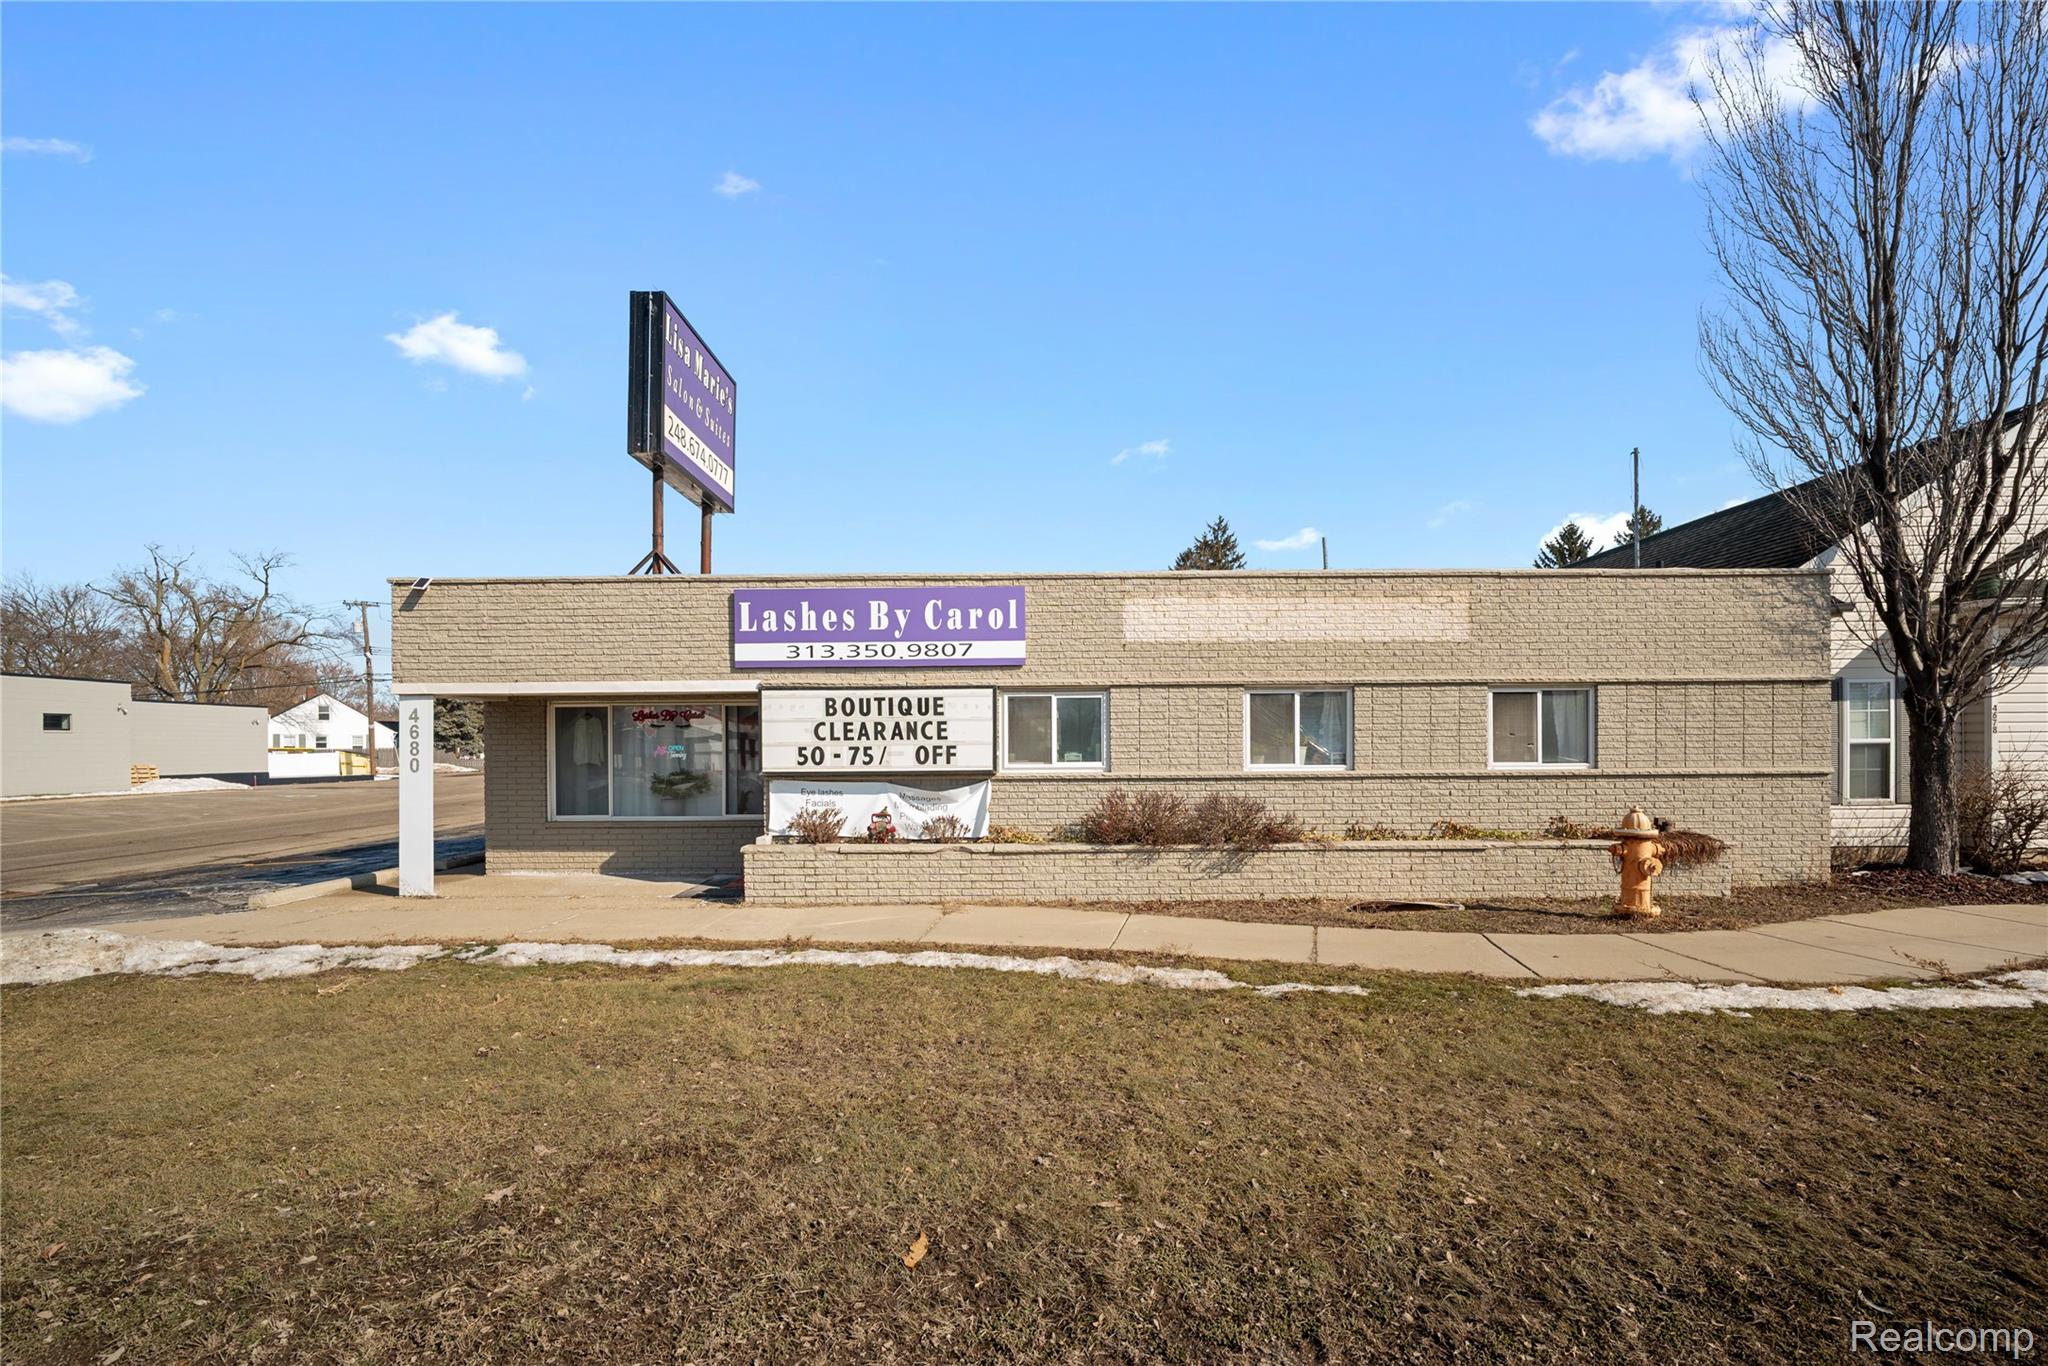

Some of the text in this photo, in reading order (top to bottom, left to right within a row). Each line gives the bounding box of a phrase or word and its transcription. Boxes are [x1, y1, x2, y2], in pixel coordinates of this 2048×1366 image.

[665, 312, 733, 415] Lisa Marie's
[666, 365, 730, 448] Salon & Suites
[668, 415, 729, 485] 248.674.0777
[739, 599, 1019, 638] Lashes By Carol
[786, 643, 973, 660] 313.350.9807
[825, 696, 945, 718] BOUTIQUE
[408, 707, 420, 773] 4680
[813, 720, 949, 742] CLEARANCE
[915, 745, 957, 765] OFF
[805, 798, 837, 808] Facials
